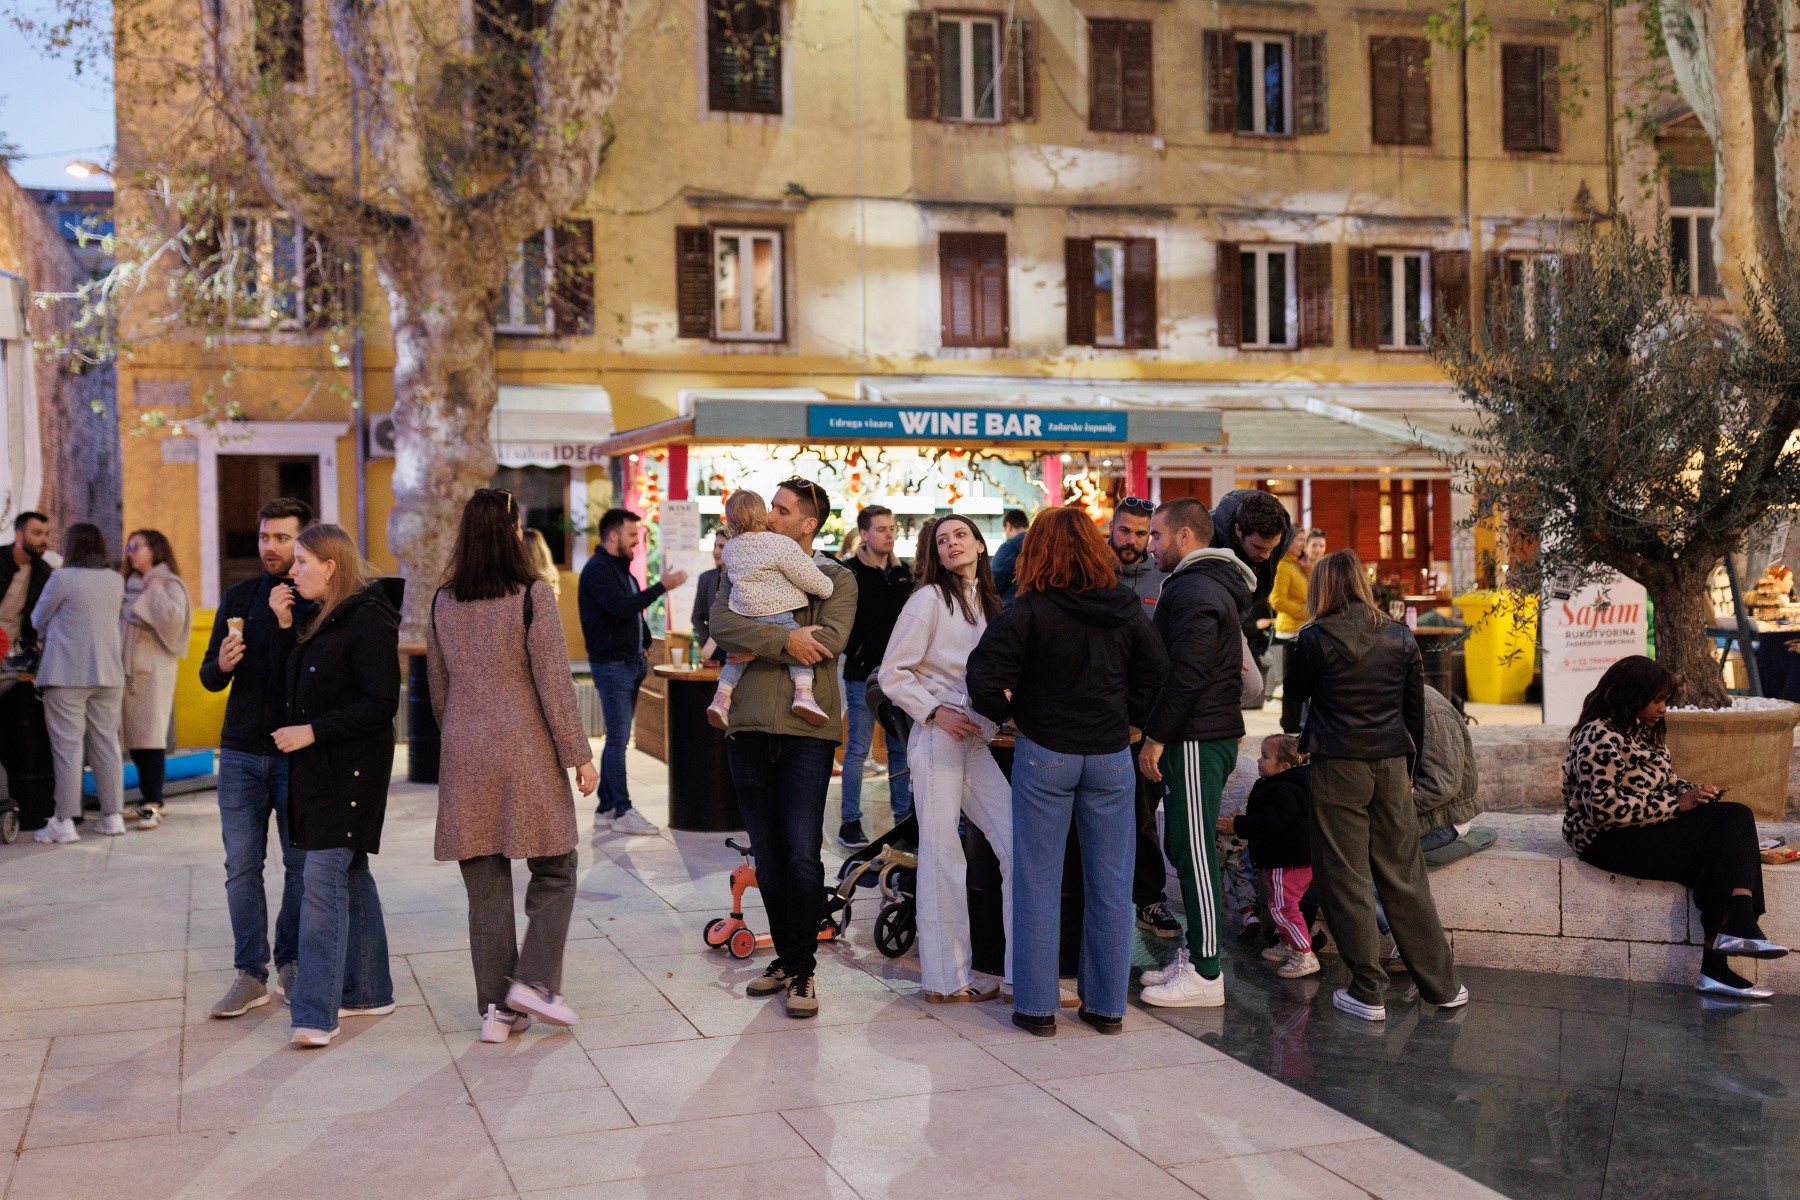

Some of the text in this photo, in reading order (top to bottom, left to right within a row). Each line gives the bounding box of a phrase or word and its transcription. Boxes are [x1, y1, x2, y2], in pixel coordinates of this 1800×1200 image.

[829, 411, 1117, 437] Udruga vinara WINE BAR Zadarske županije
[1559, 602, 1639, 631] Sajam
[1565, 628, 1636, 639] RUKOTVORINA
